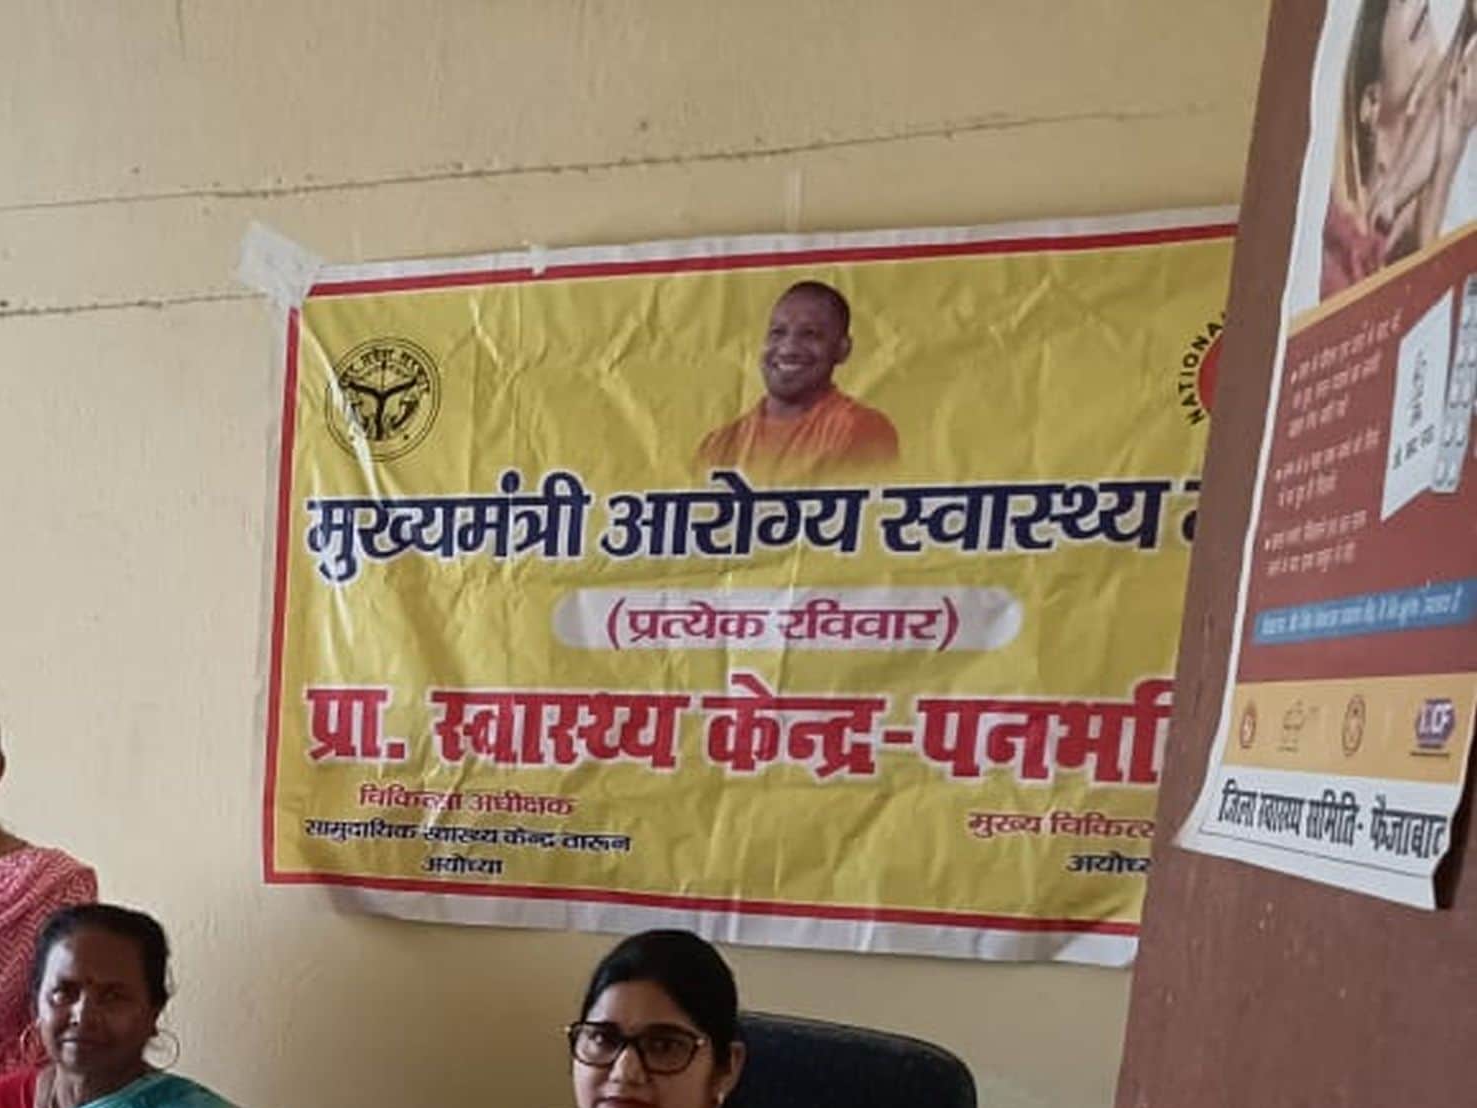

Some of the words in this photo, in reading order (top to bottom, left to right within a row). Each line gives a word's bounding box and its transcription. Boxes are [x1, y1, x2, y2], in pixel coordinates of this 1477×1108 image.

[1178, 312, 1225, 425] NATIONA
[307, 470, 590, 581] मुख्यमंत्री
[600, 472, 869, 556] आरोग्य
[880, 481, 1170, 553] स्वास्थ्य
[607, 600, 766, 651] (प्रत्येक
[776, 599, 959, 652] रविवार)
[307, 689, 406, 760] प्रा.
[432, 691, 691, 769] स्वास्थ्य
[470, 789, 578, 817] अधीक्षक
[969, 812, 1042, 837] मुख्य
[1217, 778, 1259, 827] जिला
